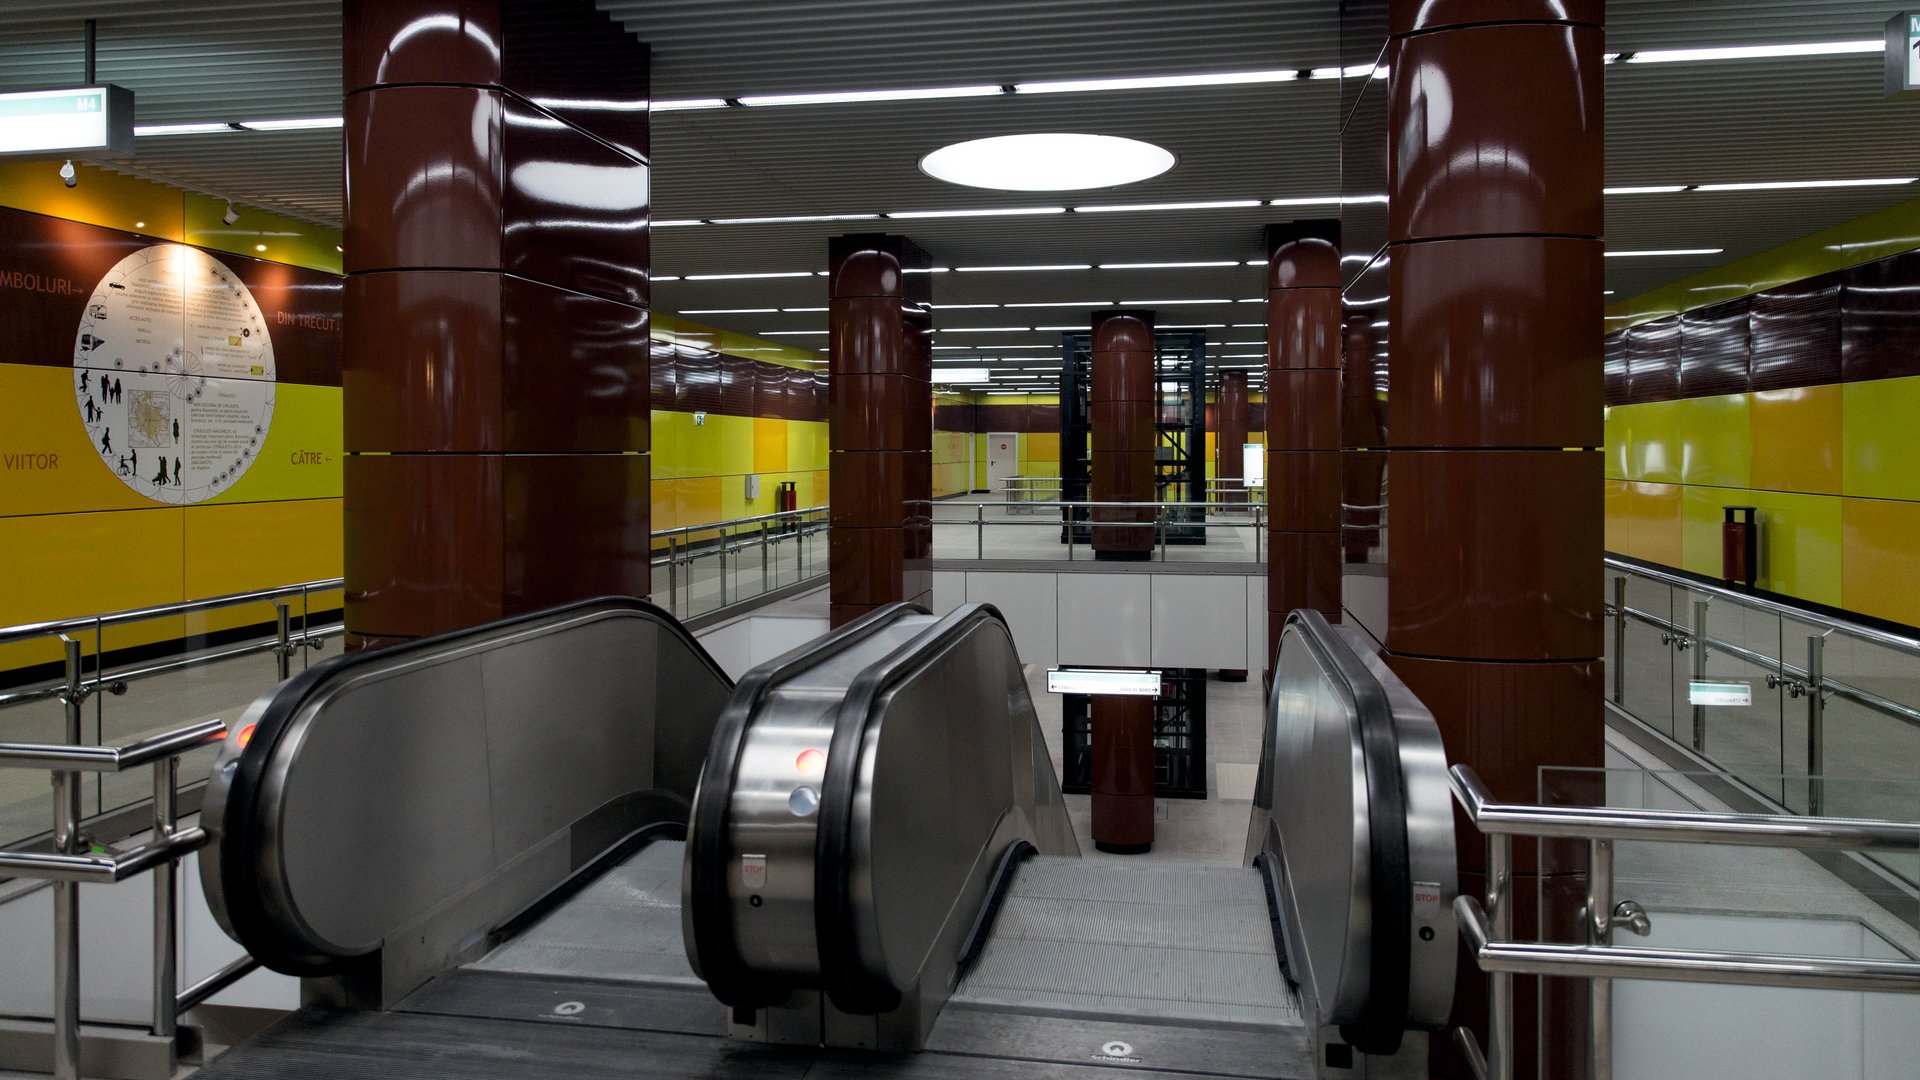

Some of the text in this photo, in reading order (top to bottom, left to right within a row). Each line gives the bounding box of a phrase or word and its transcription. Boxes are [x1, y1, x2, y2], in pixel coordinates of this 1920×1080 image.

[76, 97, 97, 112] M4
[277, 310, 336, 332] DIN TRECUT
[3, 453, 59, 470] VIITOR
[290, 449, 323, 466] CĂTRE
[744, 865, 766, 873] STOP
[1415, 893, 1440, 903] STOP
[1090, 1054, 1141, 1063] Schindler
